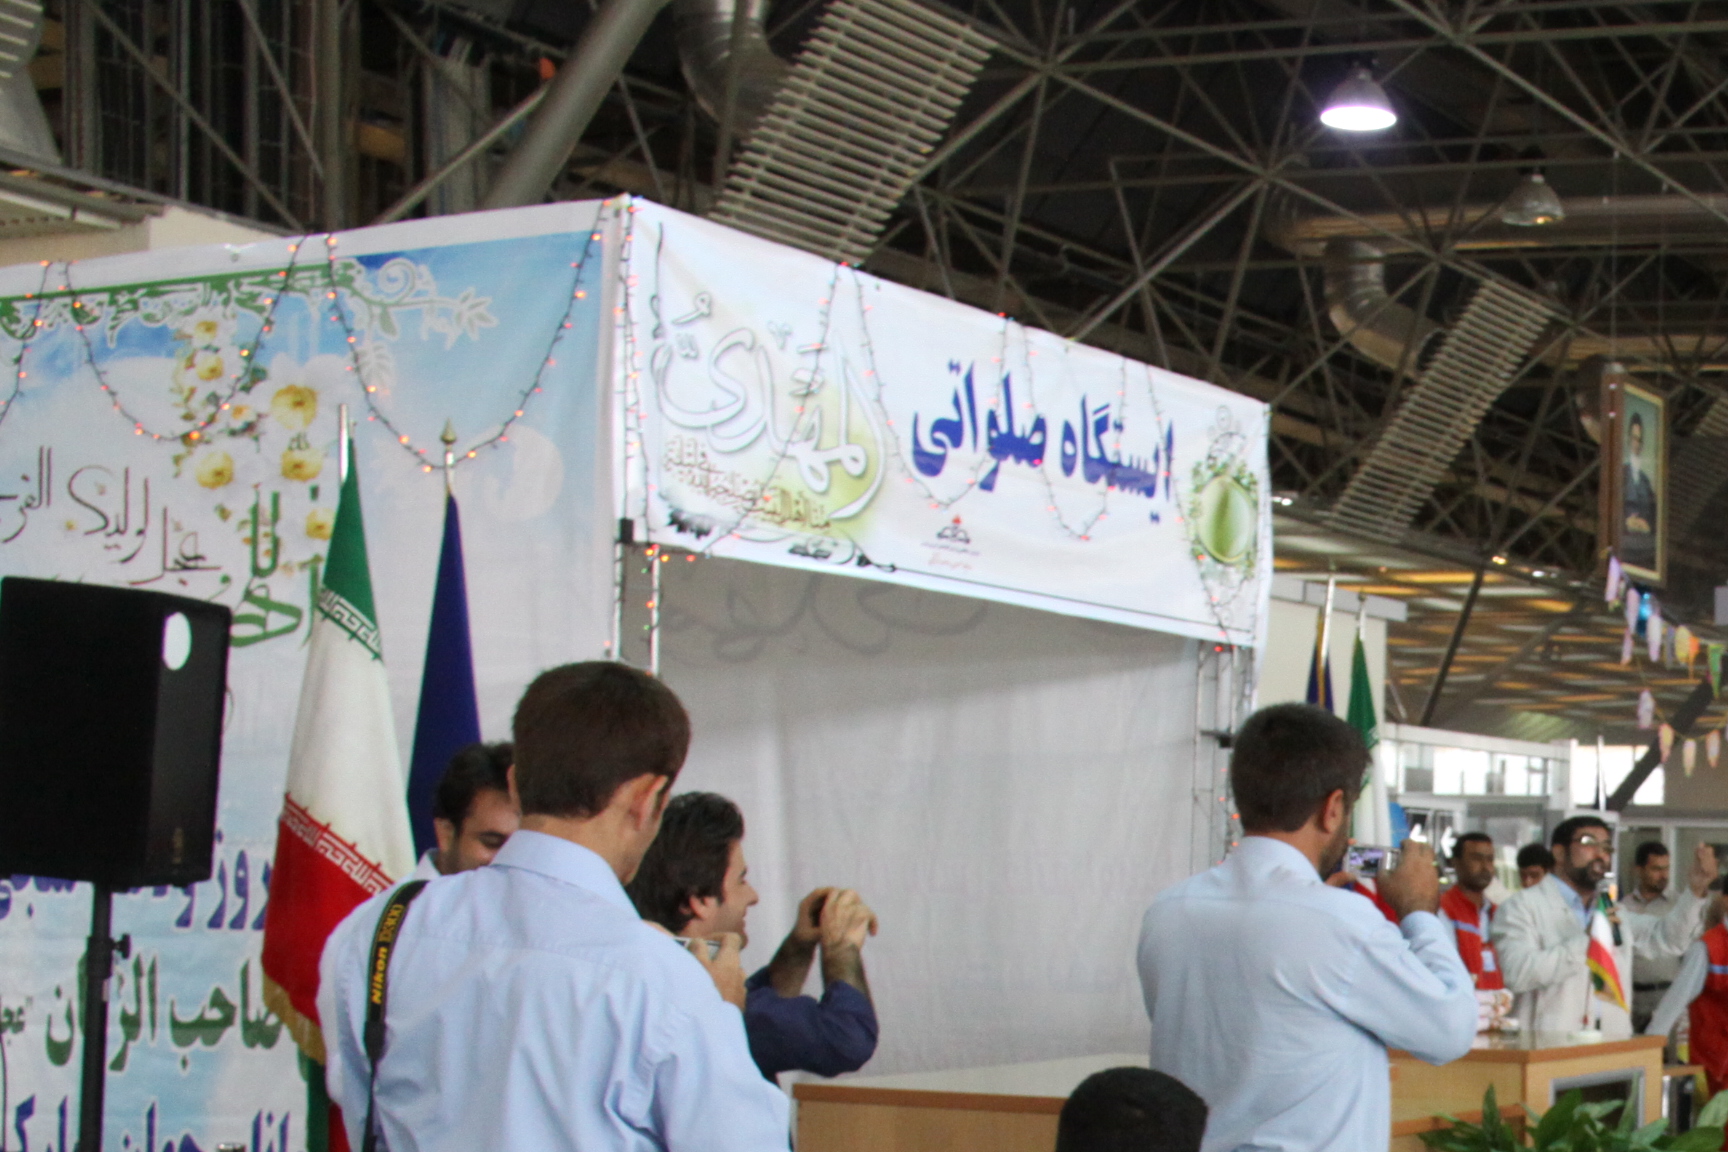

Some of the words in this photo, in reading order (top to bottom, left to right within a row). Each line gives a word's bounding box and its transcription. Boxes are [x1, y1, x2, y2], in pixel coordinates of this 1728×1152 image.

[911, 358, 1047, 493] صلواتی
[1060, 392, 1174, 524] ایستگاه
[45, 952, 158, 1071] الزان
[169, 957, 284, 1071] صاحب
[371, 946, 388, 1005] Nikon
